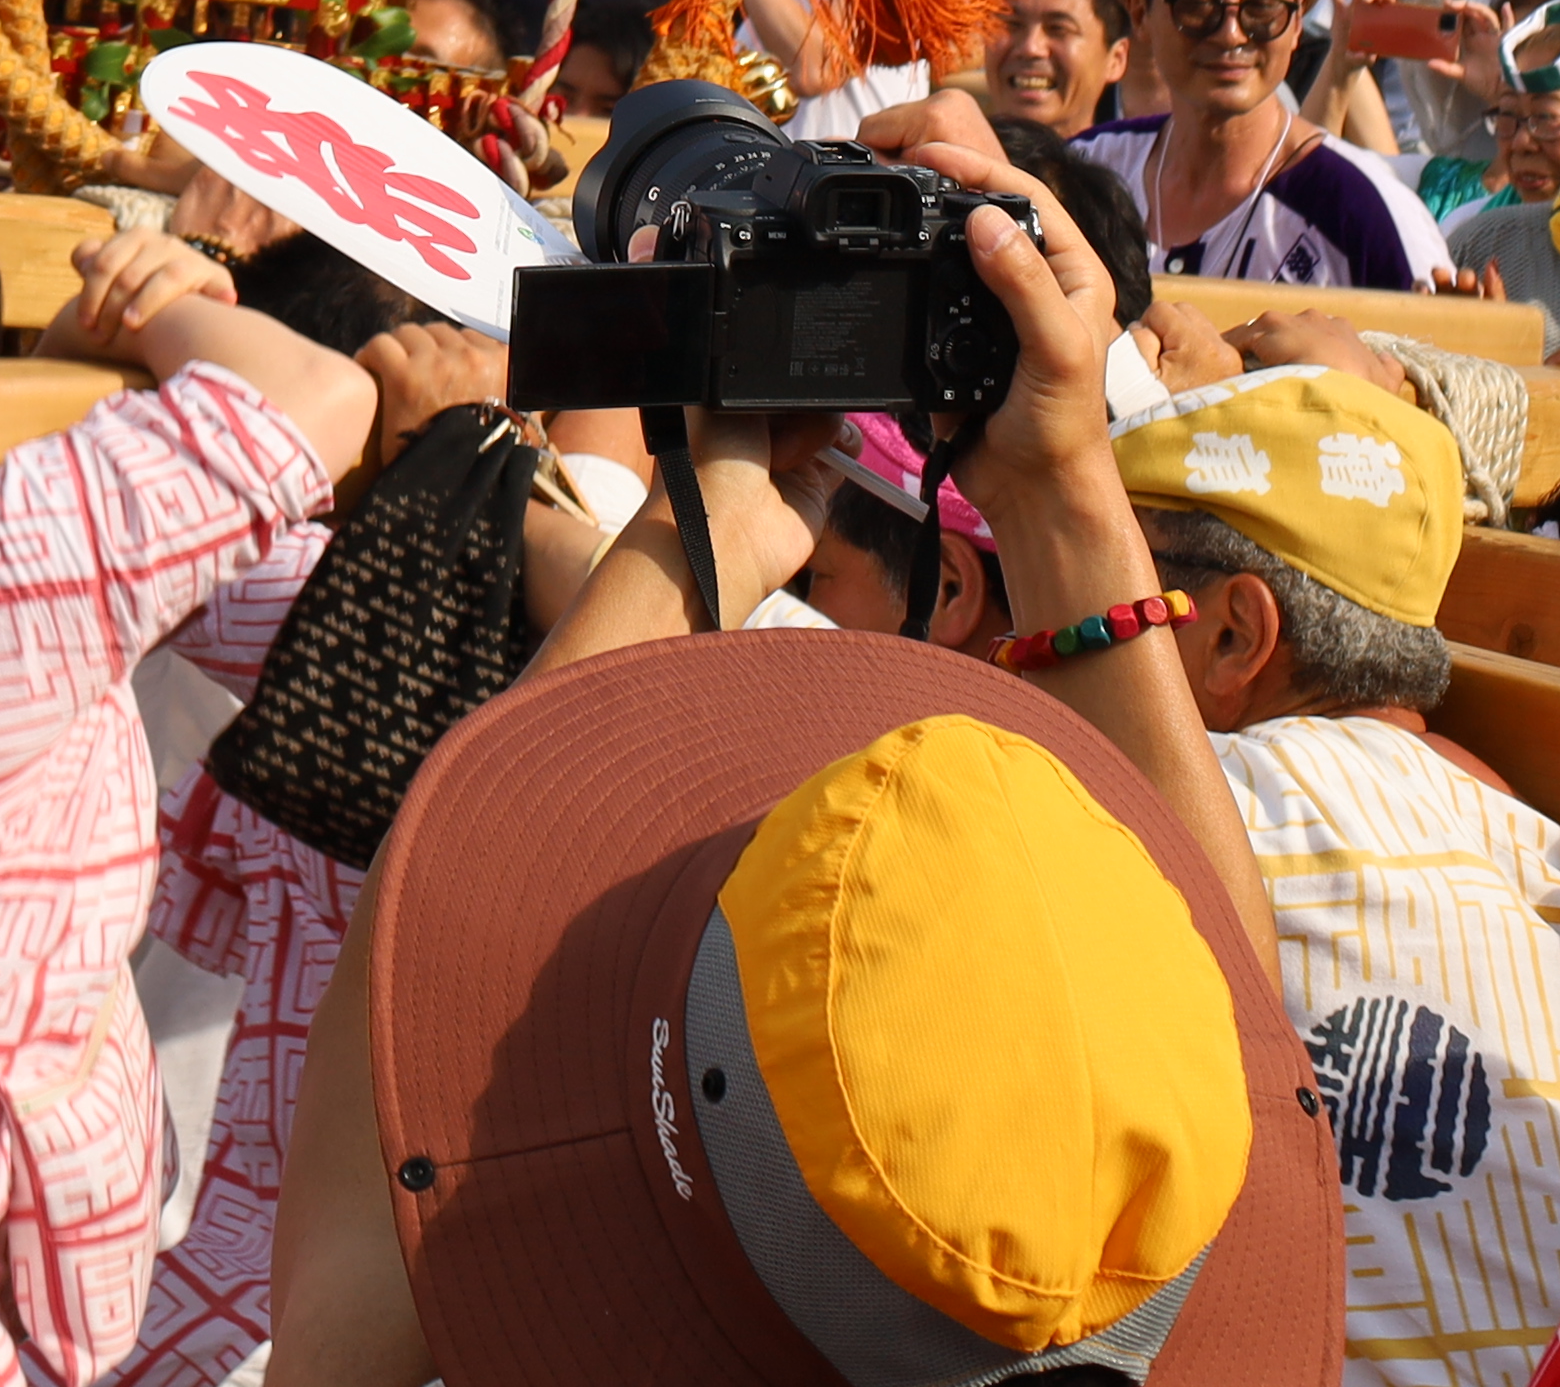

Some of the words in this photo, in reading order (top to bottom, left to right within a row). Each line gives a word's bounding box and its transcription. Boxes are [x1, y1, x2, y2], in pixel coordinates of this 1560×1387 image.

[167, 69, 483, 281] 祭
[647, 185, 662, 203] G
[767, 230, 788, 240] MENU
